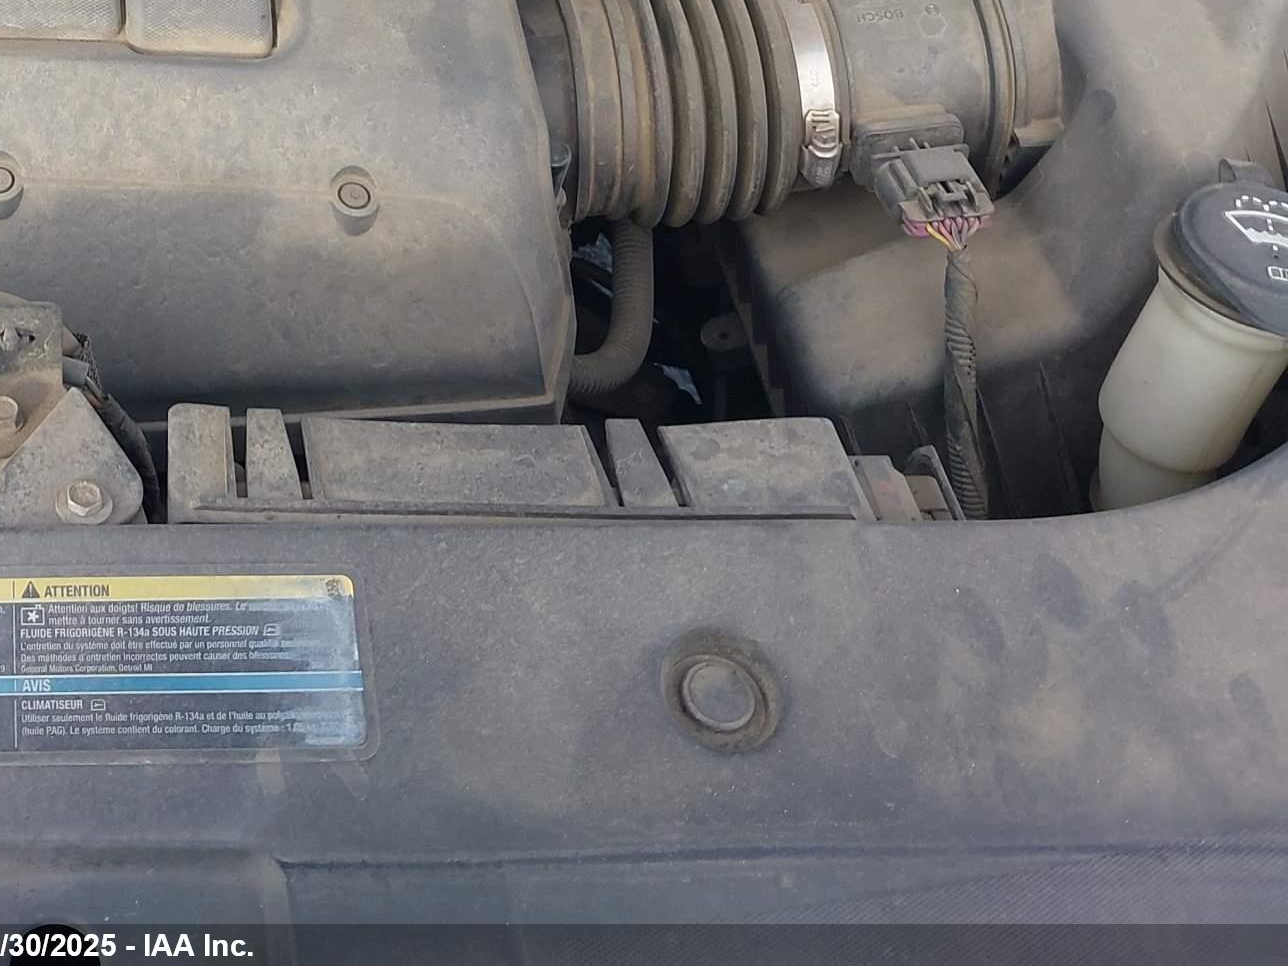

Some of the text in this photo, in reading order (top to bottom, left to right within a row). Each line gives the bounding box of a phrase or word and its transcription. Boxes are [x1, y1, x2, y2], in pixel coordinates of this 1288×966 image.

[43, 585, 111, 598] ATTENTION
[48, 604, 88, 614] Attention
[90, 605, 107, 614] aux
[141, 603, 171, 615] Risque
[173, 603, 185, 612] de
[48, 613, 212, 625] mettre à tourner sans avertissement.
[20, 628, 53, 639] FLUIDE
[117, 627, 150, 637] R-134a
[152, 627, 178, 637] SOUS
[179, 625, 210, 636] HAUTE
[212, 625, 260, 636] PRESSION
[20, 641, 61, 651] L'entretien
[64, 641, 74, 650] du
[111, 640, 127, 651] doit
[179, 640, 193, 651] par
[195, 640, 205, 648] un
[207, 638, 247, 650] personnel
[20, 653, 37, 663] Des
[39, 653, 77, 663] méthodes
[170, 652, 202, 663] peuvent
[203, 652, 231, 661] causer
[52, 664, 75, 673] Motors
[144, 663, 153, 672] MI
[22, 678, 52, 692] AVIS
[21, 699, 84, 711] CLIMATISEUR
[21, 713, 50, 722] Utiliser
[51, 713, 93, 722] seulement
[95, 712, 103, 721] le
[106, 712, 128, 721] fluide
[175, 711, 205, 721] R-134a
[206, 711, 215, 720] et
[216, 711, 226, 720] de
[21, 725, 44, 736] (huile
[45, 725, 67, 736] PAG).
[69, 724, 79, 734] Le
[81, 724, 116, 737] système
[117, 724, 150, 734] contient
[152, 724, 162, 733] du
[201, 722, 231, 735] Charge
[232, 722, 244, 732] du
